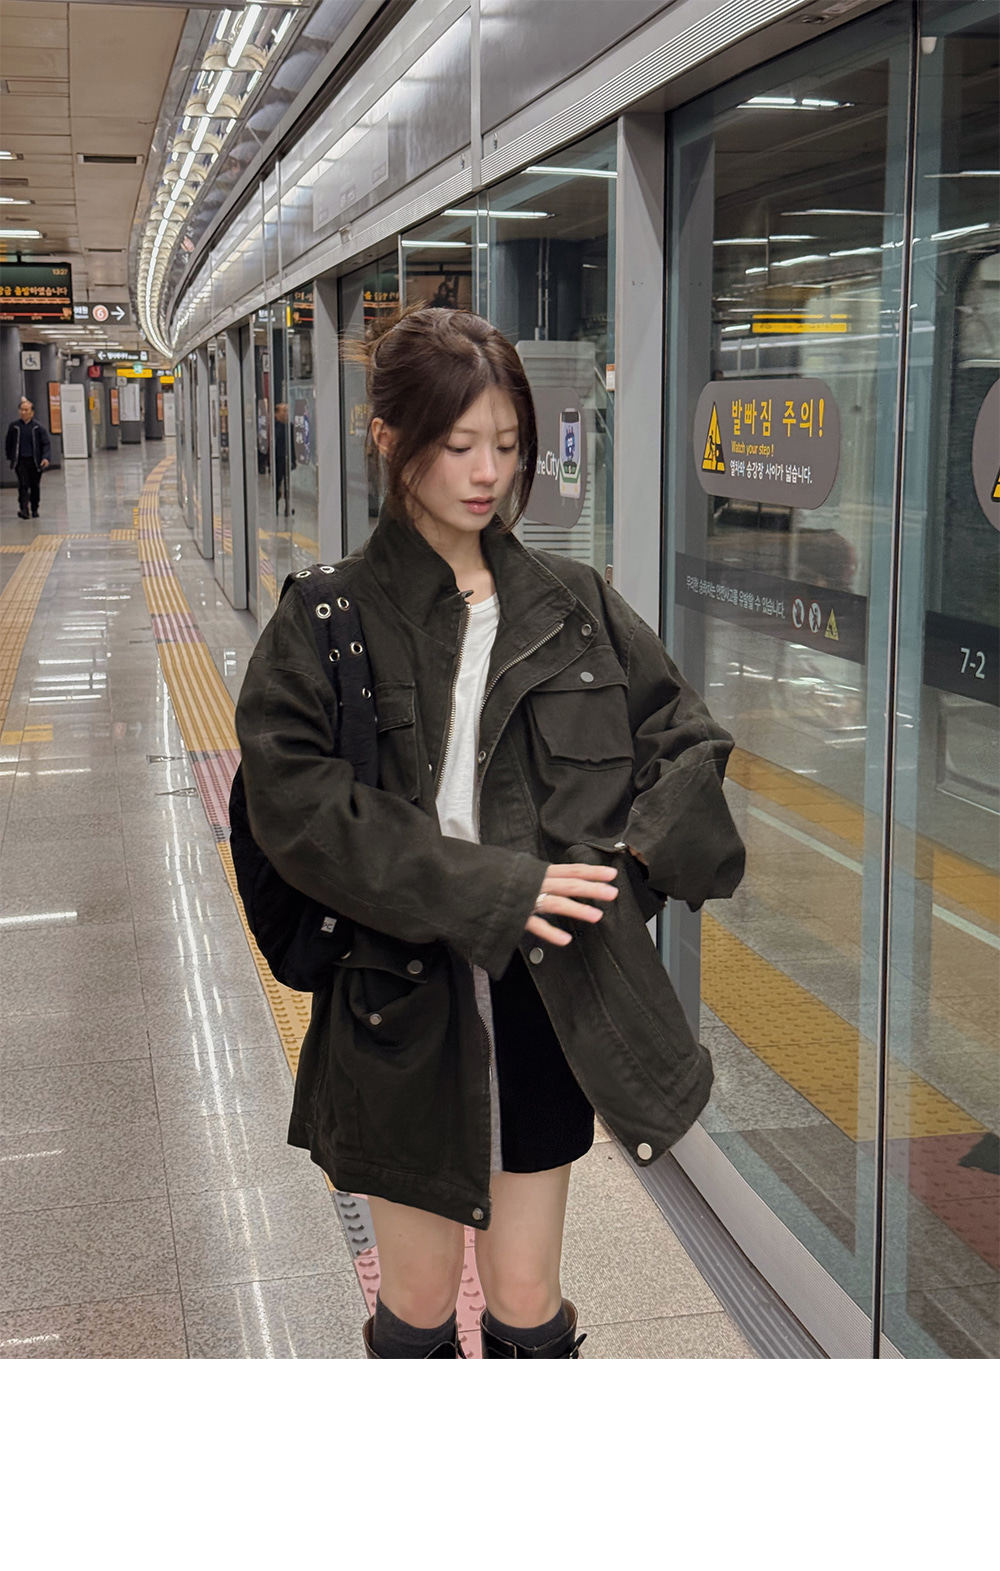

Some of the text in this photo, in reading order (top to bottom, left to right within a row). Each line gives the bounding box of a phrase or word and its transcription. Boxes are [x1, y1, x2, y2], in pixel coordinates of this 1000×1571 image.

[731, 398, 825, 438] 발빠짐 주의!
[731, 441, 746, 454] Watch
[746, 444, 759, 456] your
[729, 459, 813, 484] 열차와 승강장 사이가 넓습니다.
[960, 647, 986, 680] 7-2
